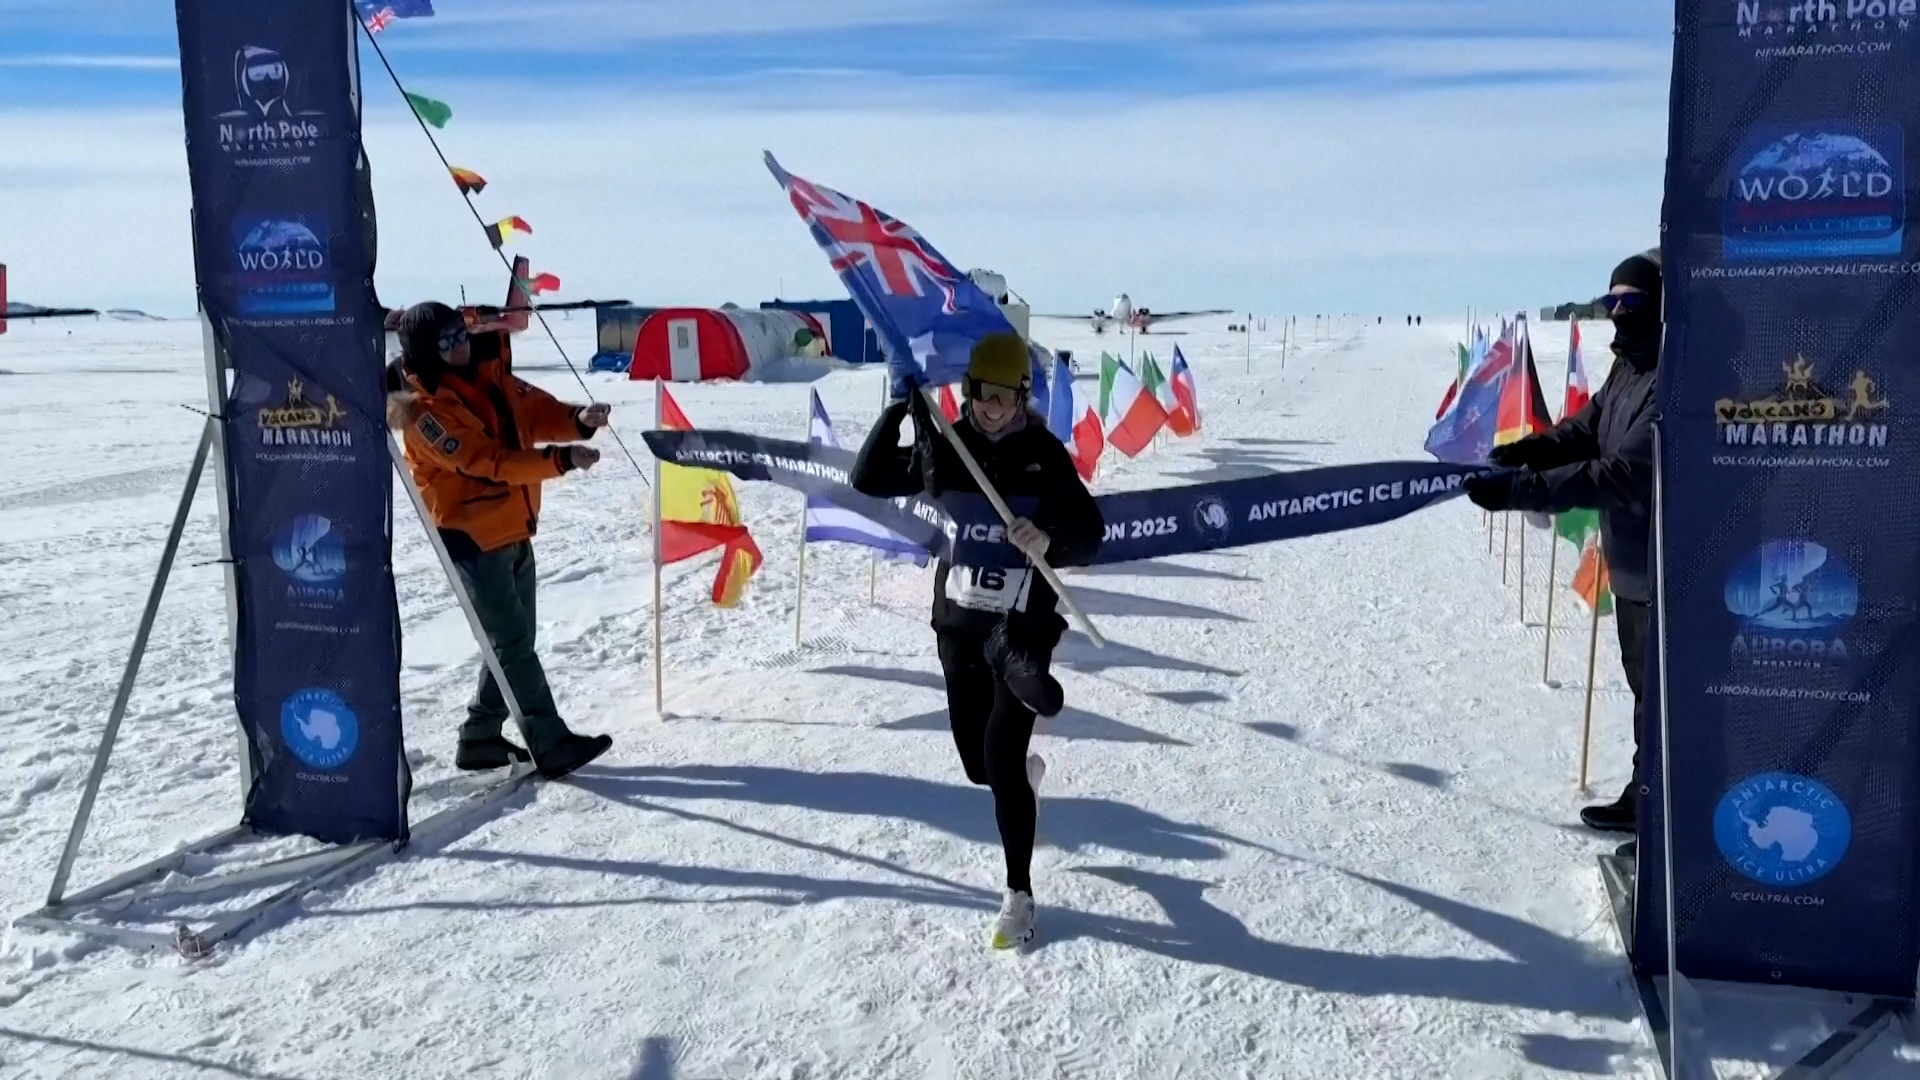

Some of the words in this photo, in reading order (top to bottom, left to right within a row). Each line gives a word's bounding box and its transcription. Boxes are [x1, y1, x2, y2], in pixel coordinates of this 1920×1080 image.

[1738, 19, 1910, 37] MARATHON
[1755, 42, 1892, 58] NPMARATHON.COM
[279, 120, 319, 139] Pole
[1719, 401, 1827, 421] VOLCANO
[262, 427, 352, 447] MARATHON
[1725, 423, 1888, 446] MARATHON
[775, 456, 849, 486] MARATHON
[1712, 456, 1890, 468] VOLCANOMARATHON.COM
[1248, 487, 1364, 522] ANTARCTIC
[1368, 480, 1403, 503] ICE
[962, 523, 1005, 544] ICE
[1131, 516, 1178, 539] 2025
[970, 565, 1007, 591] 16
[1731, 635, 1848, 657] AURORA
[1752, 659, 1821, 669] MARATHON
[1704, 684, 1872, 703] AURORAMARATHON.COM
[1732, 778, 1834, 810] ANTARCTIC
[1736, 855, 1766, 877] ICE
[1775, 857, 1828, 881] ULTRA
